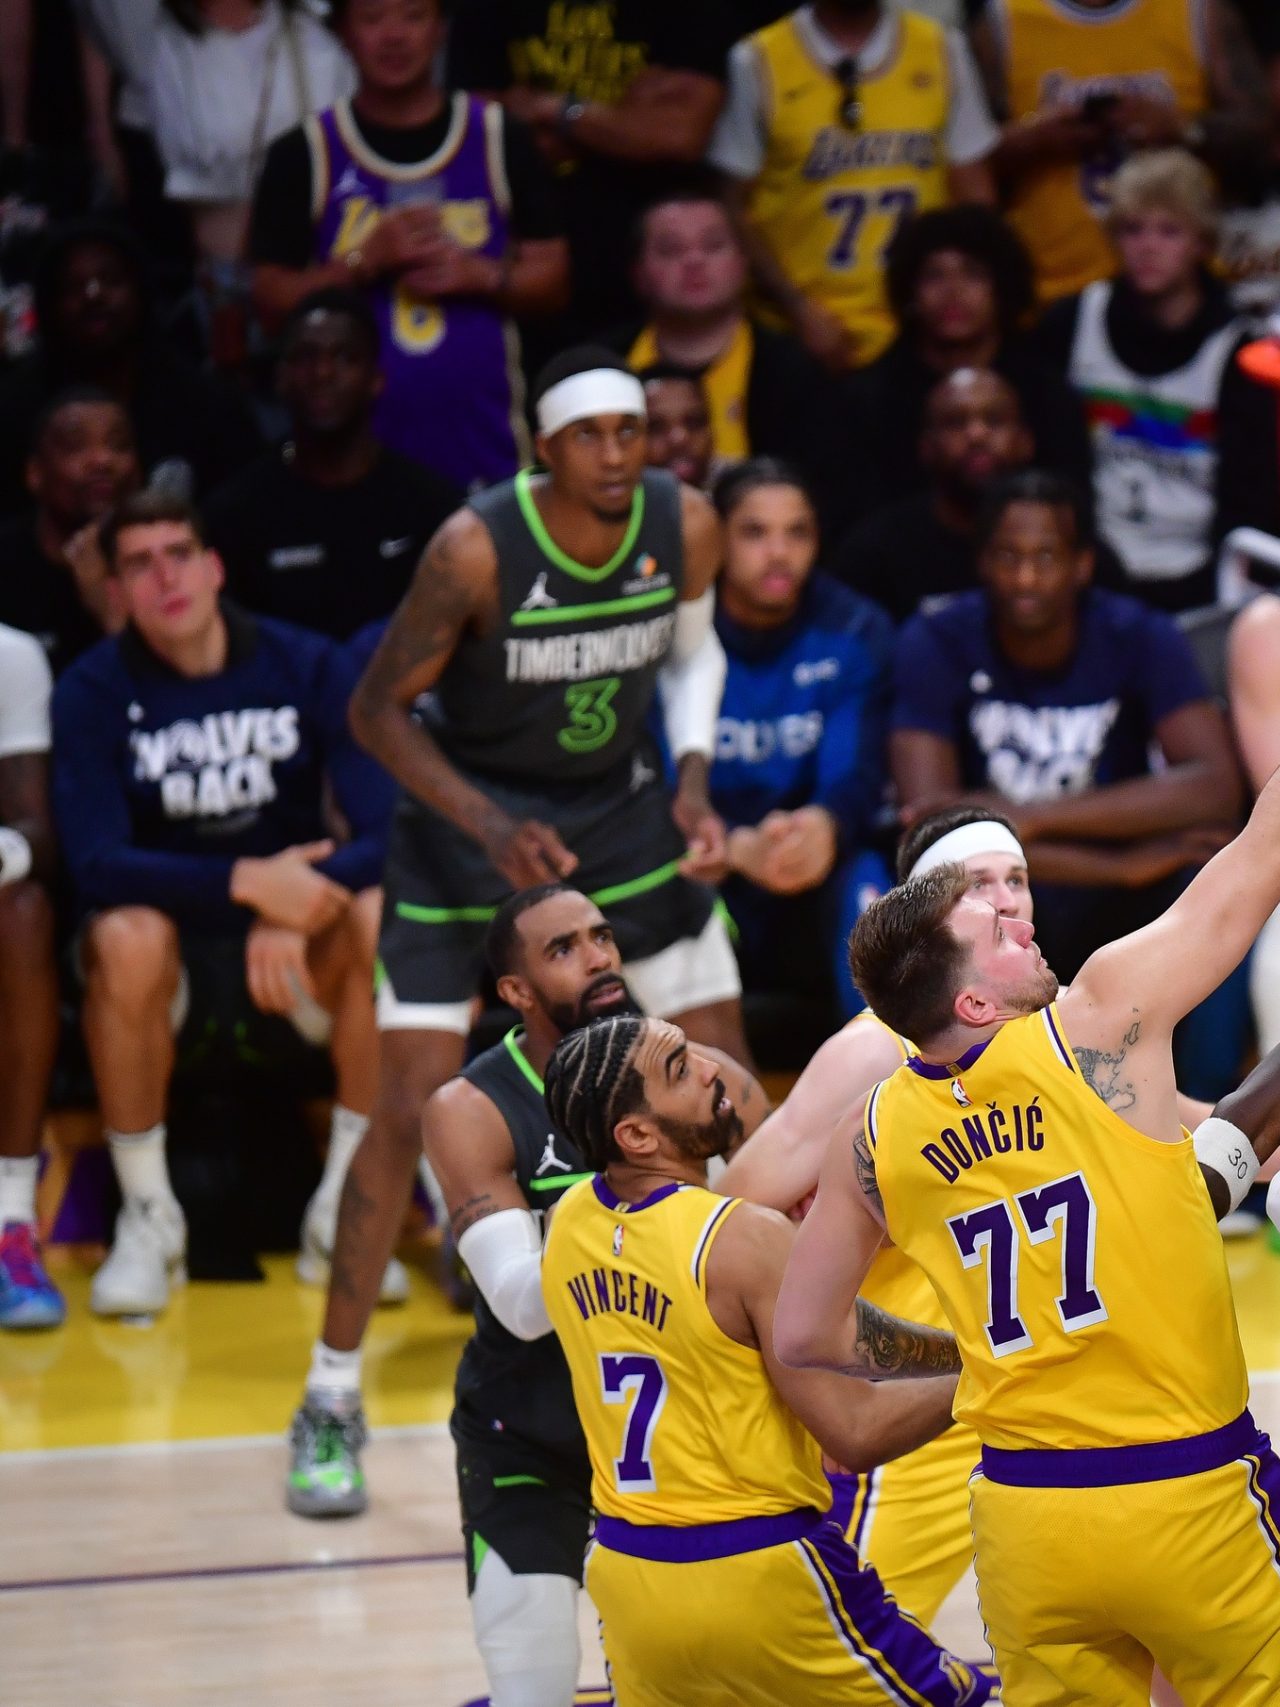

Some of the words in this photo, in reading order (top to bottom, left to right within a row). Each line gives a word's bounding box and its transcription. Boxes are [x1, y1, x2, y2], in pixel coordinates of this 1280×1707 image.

[558, 677, 622, 753] 3
[920, 1095, 1045, 1185] DONČIĆ
[1228, 1148, 1249, 1180] 30
[566, 1267, 673, 1333] VINCENT
[944, 1169, 1109, 1360] 77
[597, 1352, 670, 1494] 7
